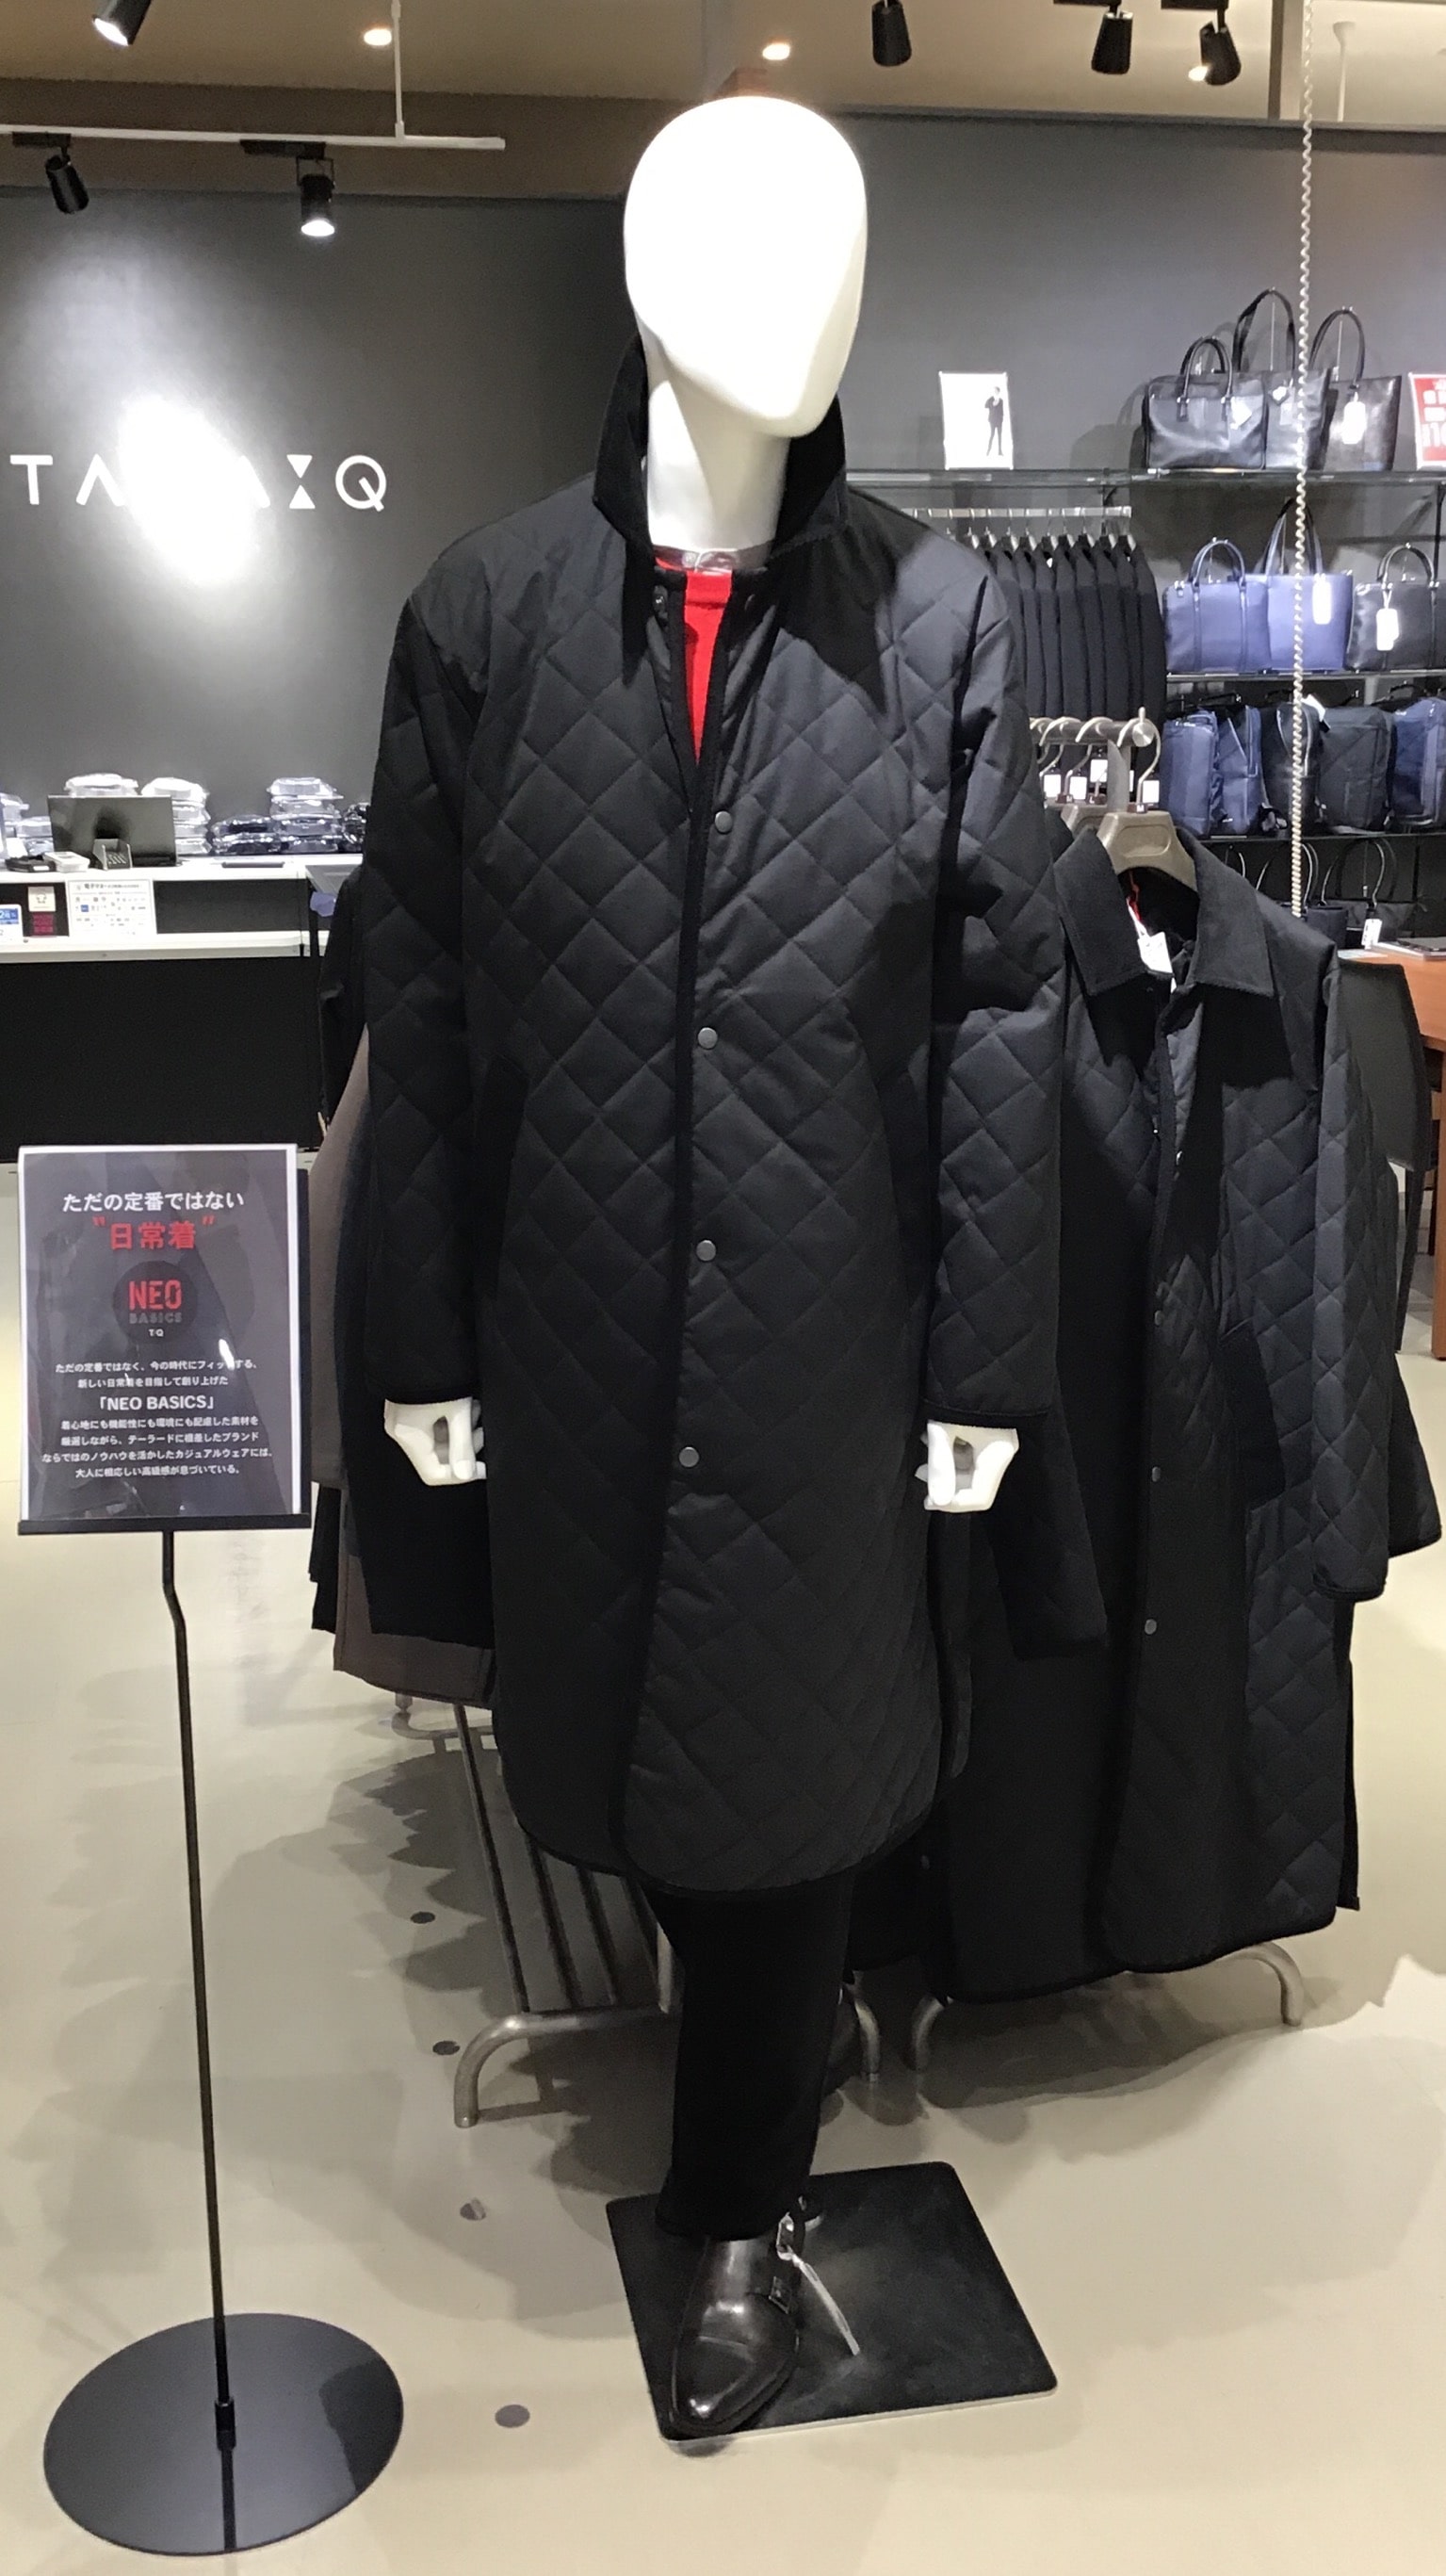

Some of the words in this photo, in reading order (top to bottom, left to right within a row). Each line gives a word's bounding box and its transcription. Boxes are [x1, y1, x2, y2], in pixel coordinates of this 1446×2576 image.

[62, 1191, 244, 1213] ただの定番ではない
[129, 1280, 183, 1311] NEO
[129, 1312, 183, 1325] BASICS
[55, 1359, 257, 1374] ただの定番ではなく、今の時代にフィッする、
